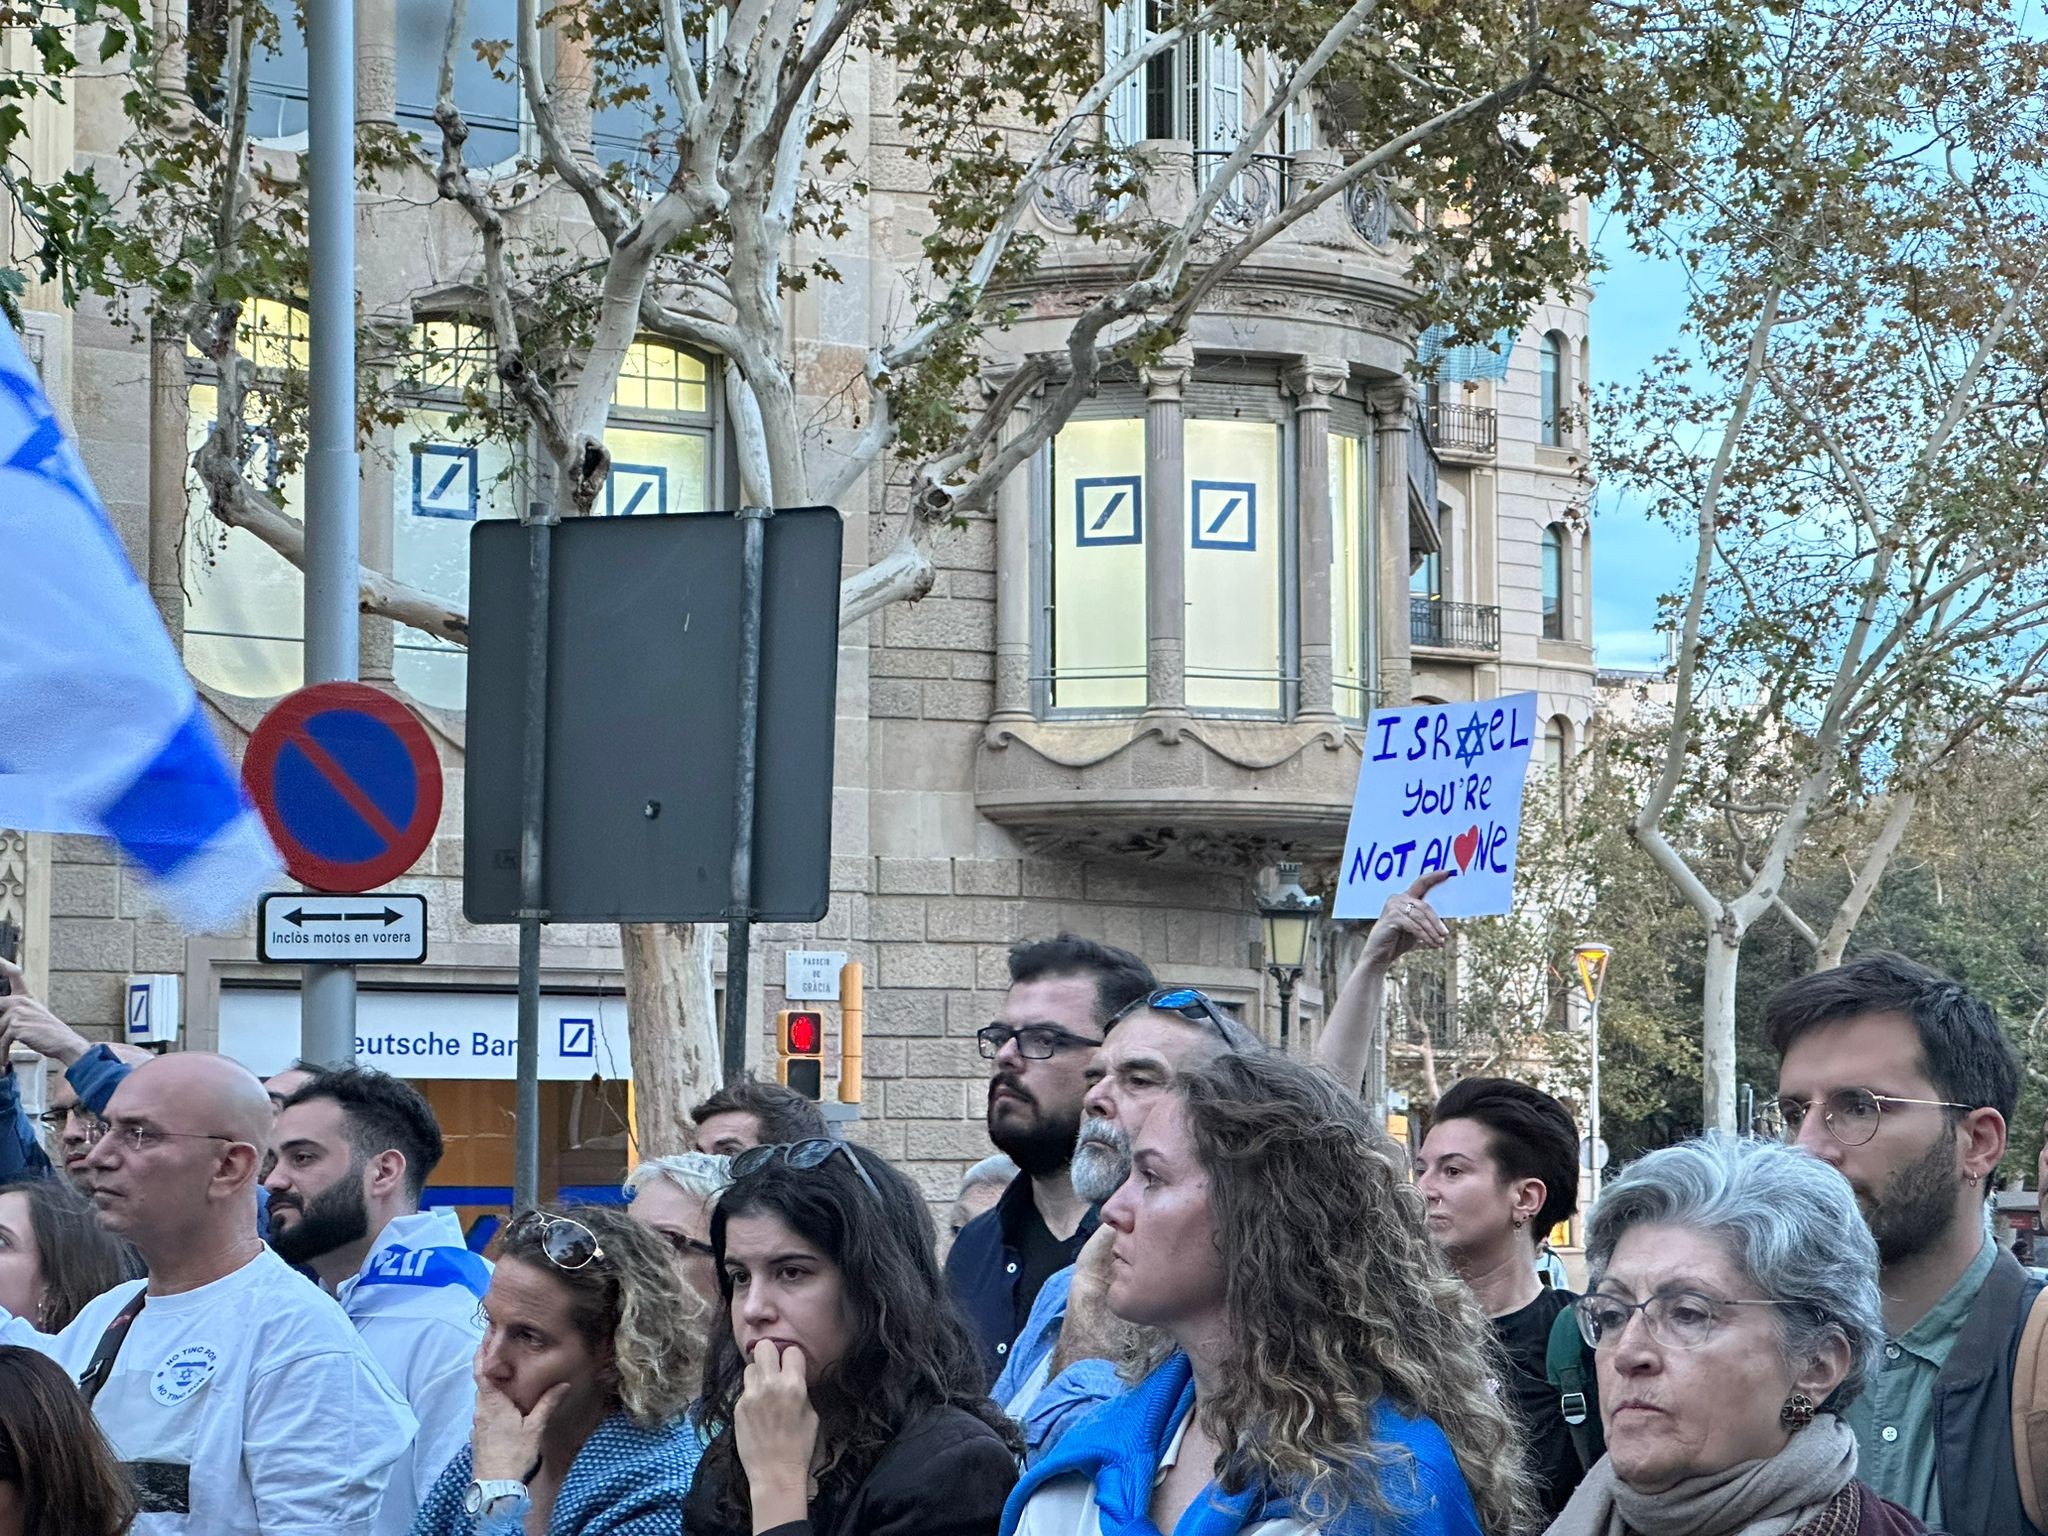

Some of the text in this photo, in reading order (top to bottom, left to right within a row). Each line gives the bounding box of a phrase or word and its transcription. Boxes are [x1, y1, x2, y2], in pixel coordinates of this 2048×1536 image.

[1348, 840, 1417, 885] NOT
[272, 931, 411, 944] Inclòs motos en vorera
[355, 1032, 518, 1056] eutsche Ban
[166, 1354, 179, 1366] NO
[157, 1384, 168, 1396] NO
